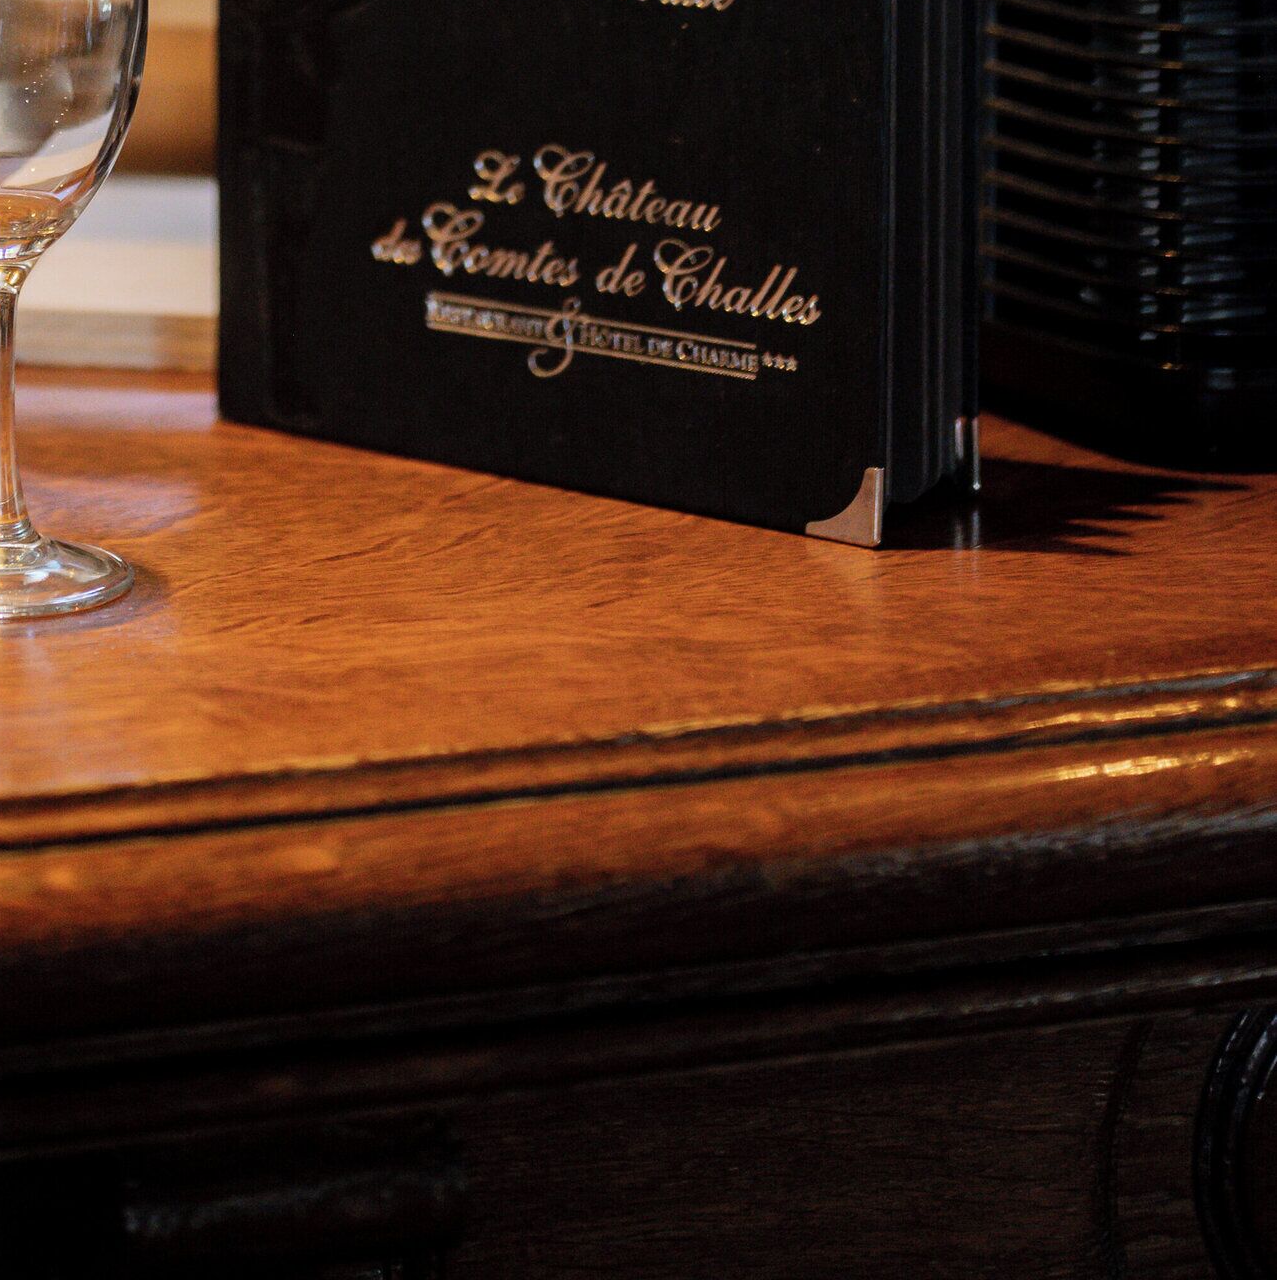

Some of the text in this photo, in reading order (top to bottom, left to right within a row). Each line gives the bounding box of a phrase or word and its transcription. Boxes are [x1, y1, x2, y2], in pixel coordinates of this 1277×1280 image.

[468, 143, 721, 232] Le Château
[421, 200, 580, 288] Comtes
[595, 242, 646, 297] de
[653, 238, 822, 326] Challes
